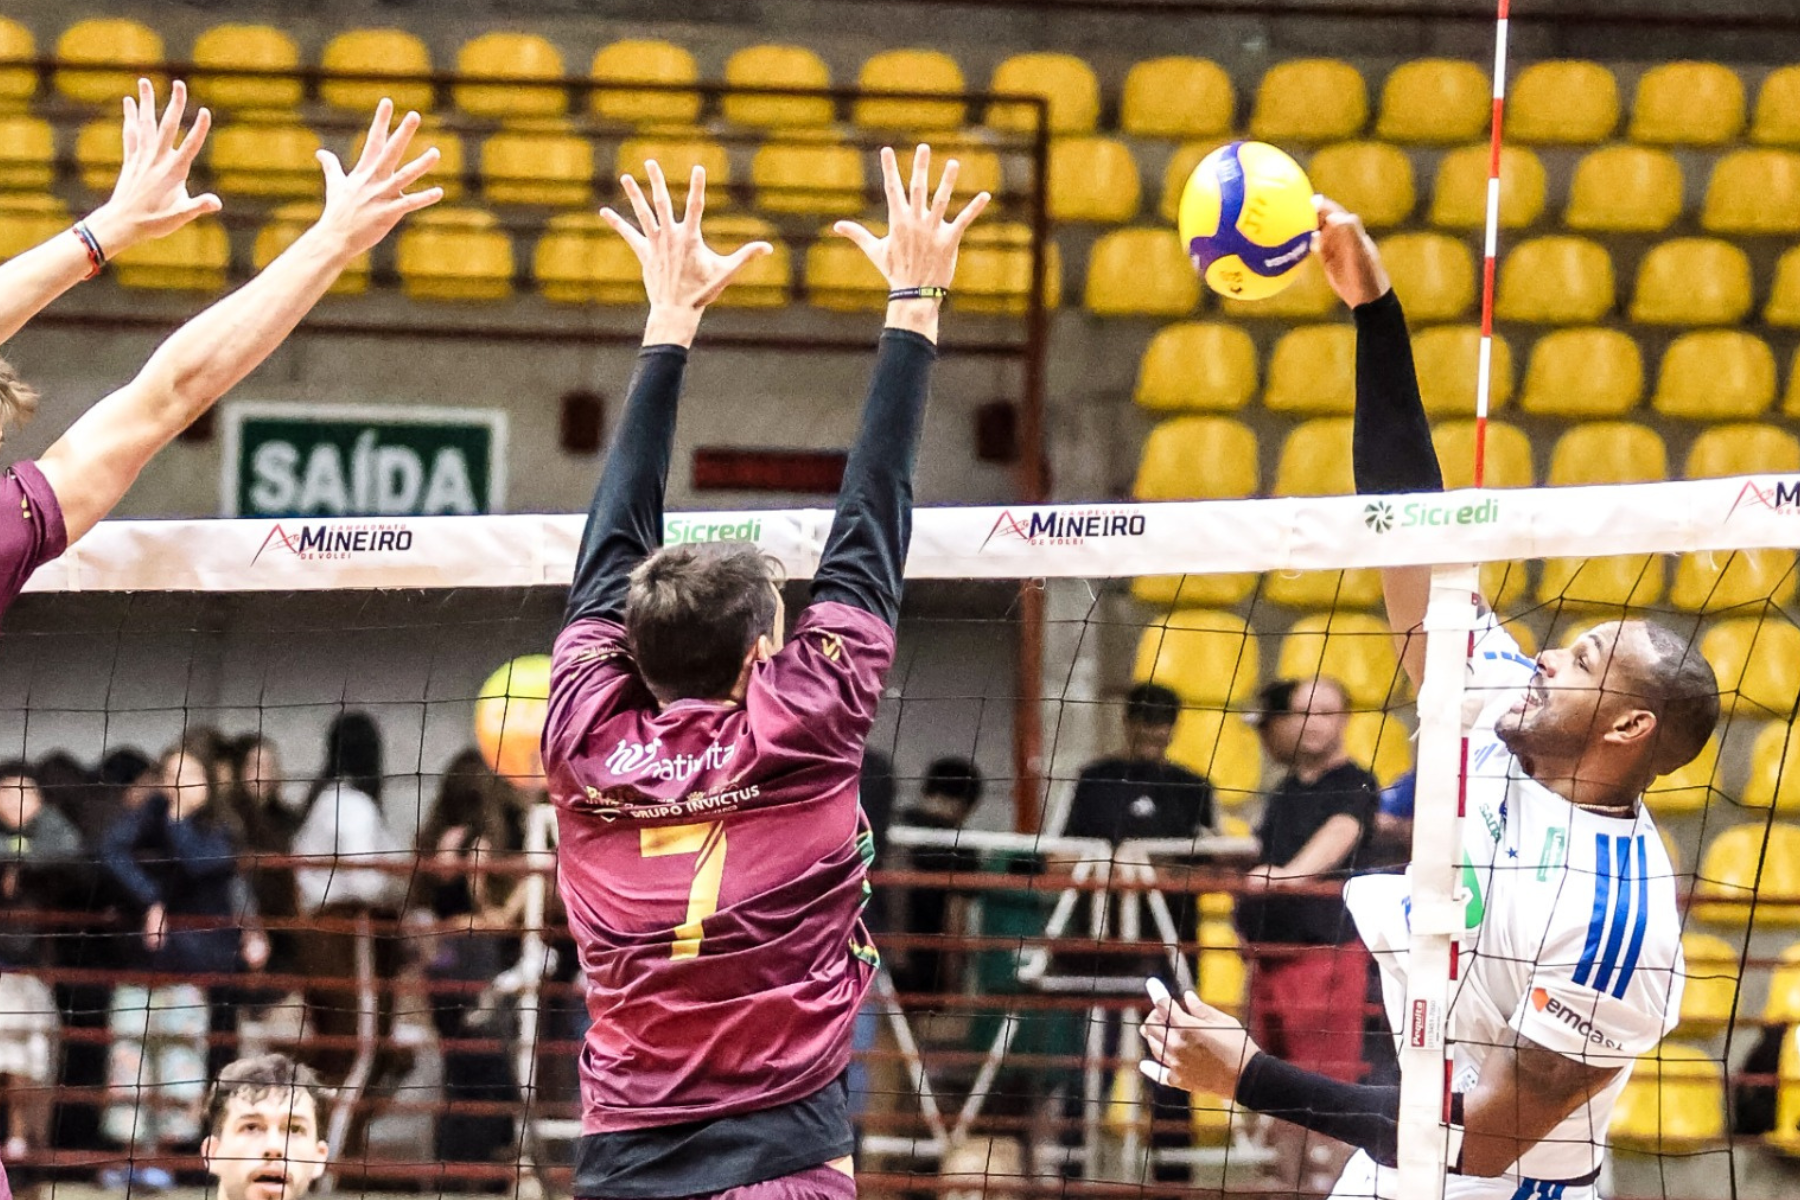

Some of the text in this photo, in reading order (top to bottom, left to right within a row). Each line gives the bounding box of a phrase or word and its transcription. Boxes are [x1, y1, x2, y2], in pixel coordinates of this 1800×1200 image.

[252, 428, 478, 515] SAÍDA
[1401, 499, 1499, 527] Sicredi
[664, 518, 762, 543] Sicredi
[686, 785, 761, 813] INVICTUS
[640, 819, 728, 961] 7
